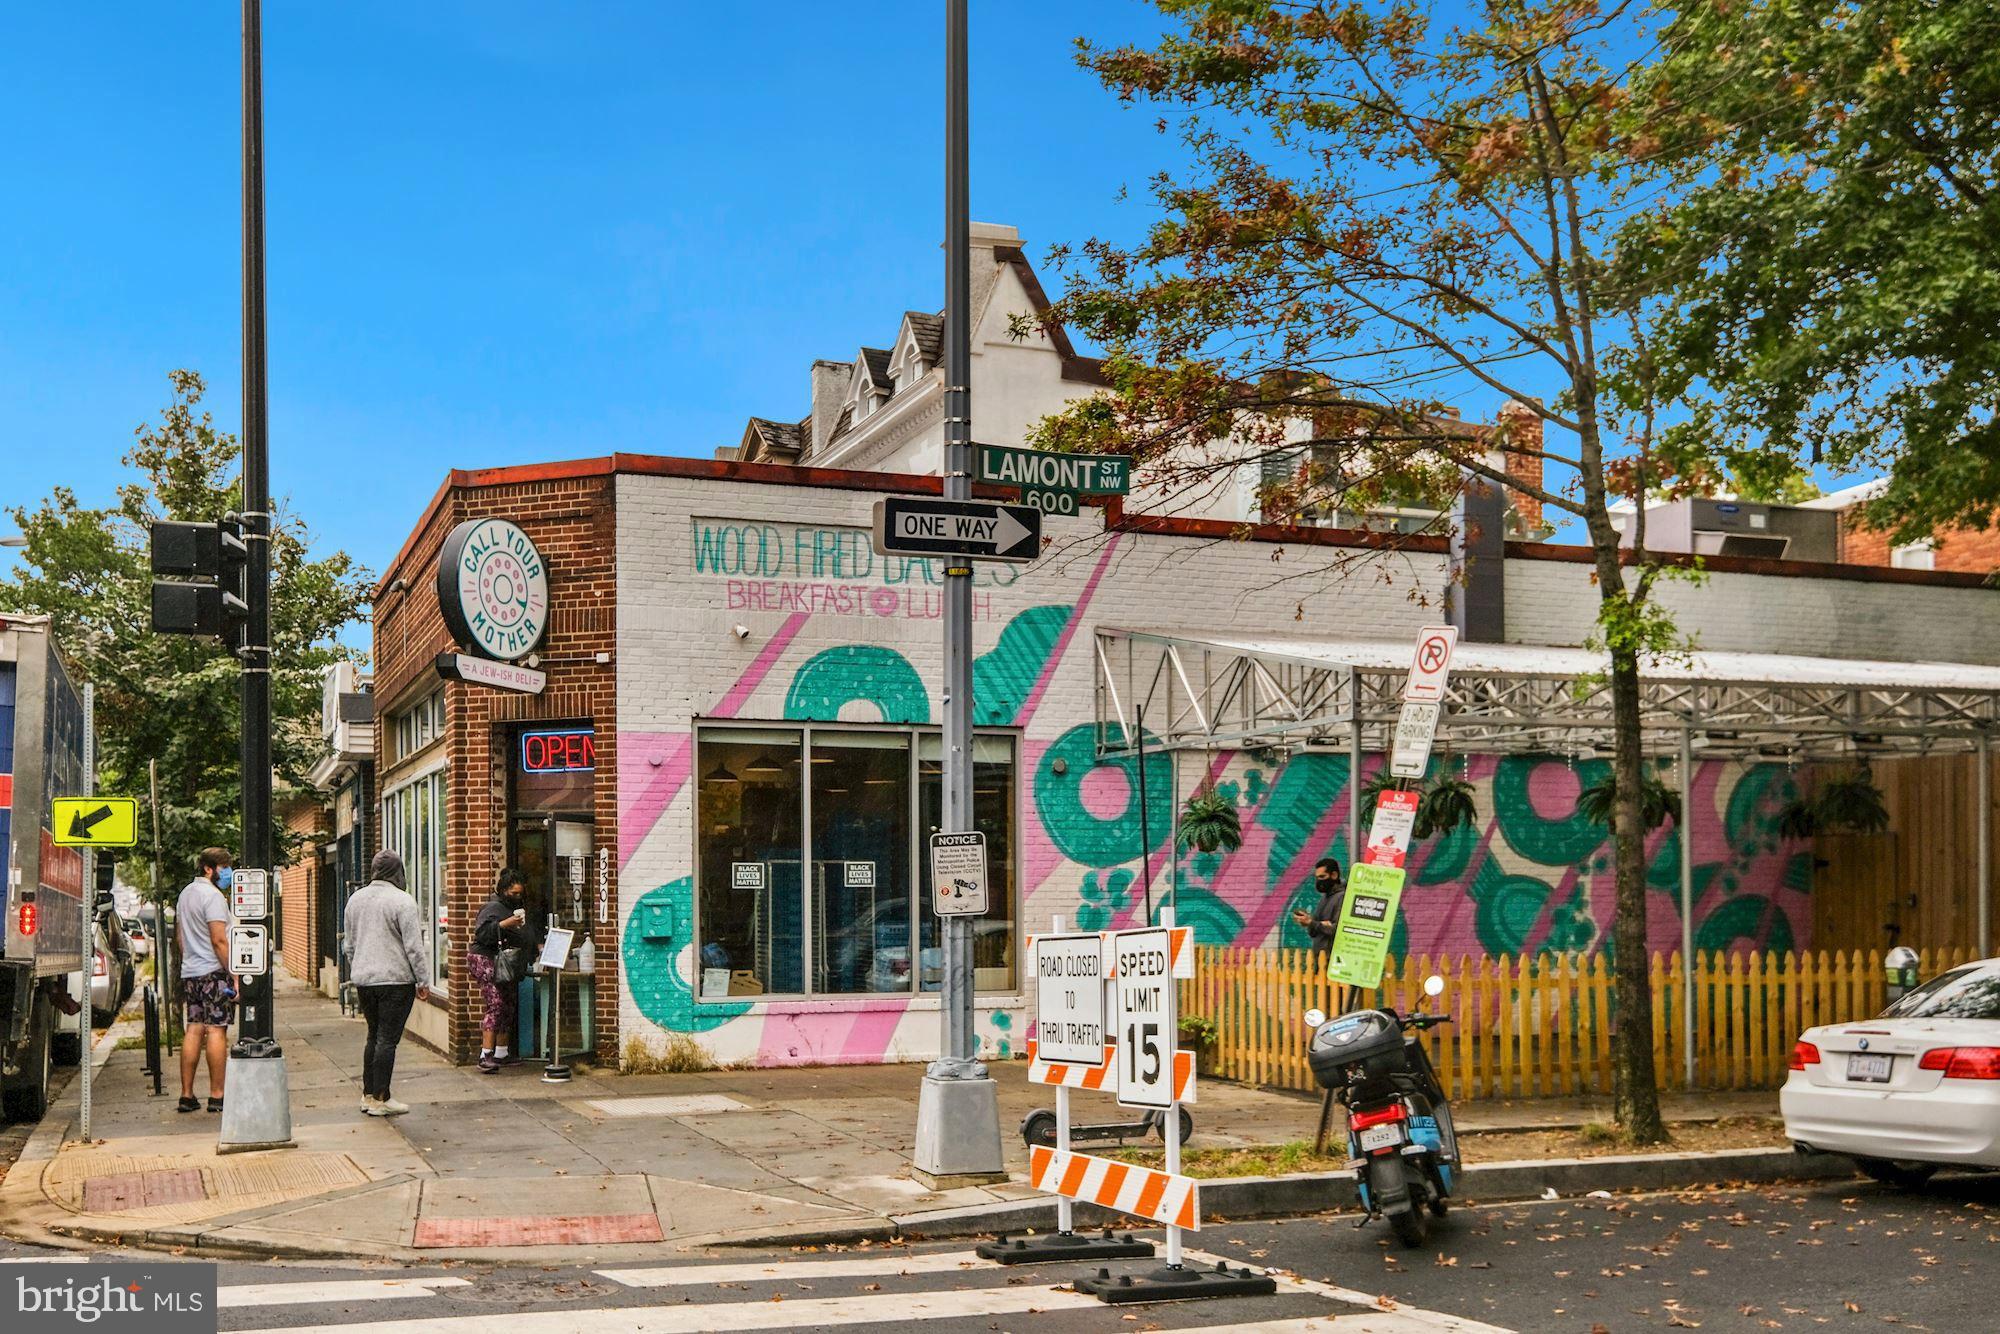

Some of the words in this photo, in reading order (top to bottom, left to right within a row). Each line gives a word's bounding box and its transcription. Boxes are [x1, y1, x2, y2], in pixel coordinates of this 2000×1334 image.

[983, 450, 1097, 489] LAMONT
[1101, 461, 1121, 475] ST
[1100, 475, 1122, 489] NW
[1026, 490, 1073, 514] 600
[904, 515, 946, 537] ONE
[955, 518, 999, 540] WAY
[464, 527, 500, 573] CALL
[506, 528, 540, 579] YOUR
[692, 519, 783, 578] WOOD
[794, 527, 873, 580] FIRED
[727, 579, 868, 614] BREAKFAST
[907, 587, 992, 622] LUH
[472, 610, 537, 652] MOTHER
[471, 663, 477, 674] A
[480, 665, 513, 681] JEW-ISH
[515, 672, 532, 686] DELI
[1404, 708, 1410, 721] 2
[1412, 709, 1434, 723] HOUR
[1400, 724, 1431, 739] PARKING
[525, 735, 595, 769] OPEN
[938, 835, 977, 846] NOTICE
[600, 856, 608, 917] 3301
[1040, 956, 1062, 977] ROAD
[1067, 954, 1098, 977] CLOSED
[1120, 950, 1165, 978] SPEED
[1065, 990, 1075, 1009] TO
[1125, 987, 1160, 1012] LIMIT
[1041, 1022, 1063, 1044] THRU
[1067, 1023, 1100, 1046] TRAFFIC
[1127, 1023, 1161, 1085] 15
